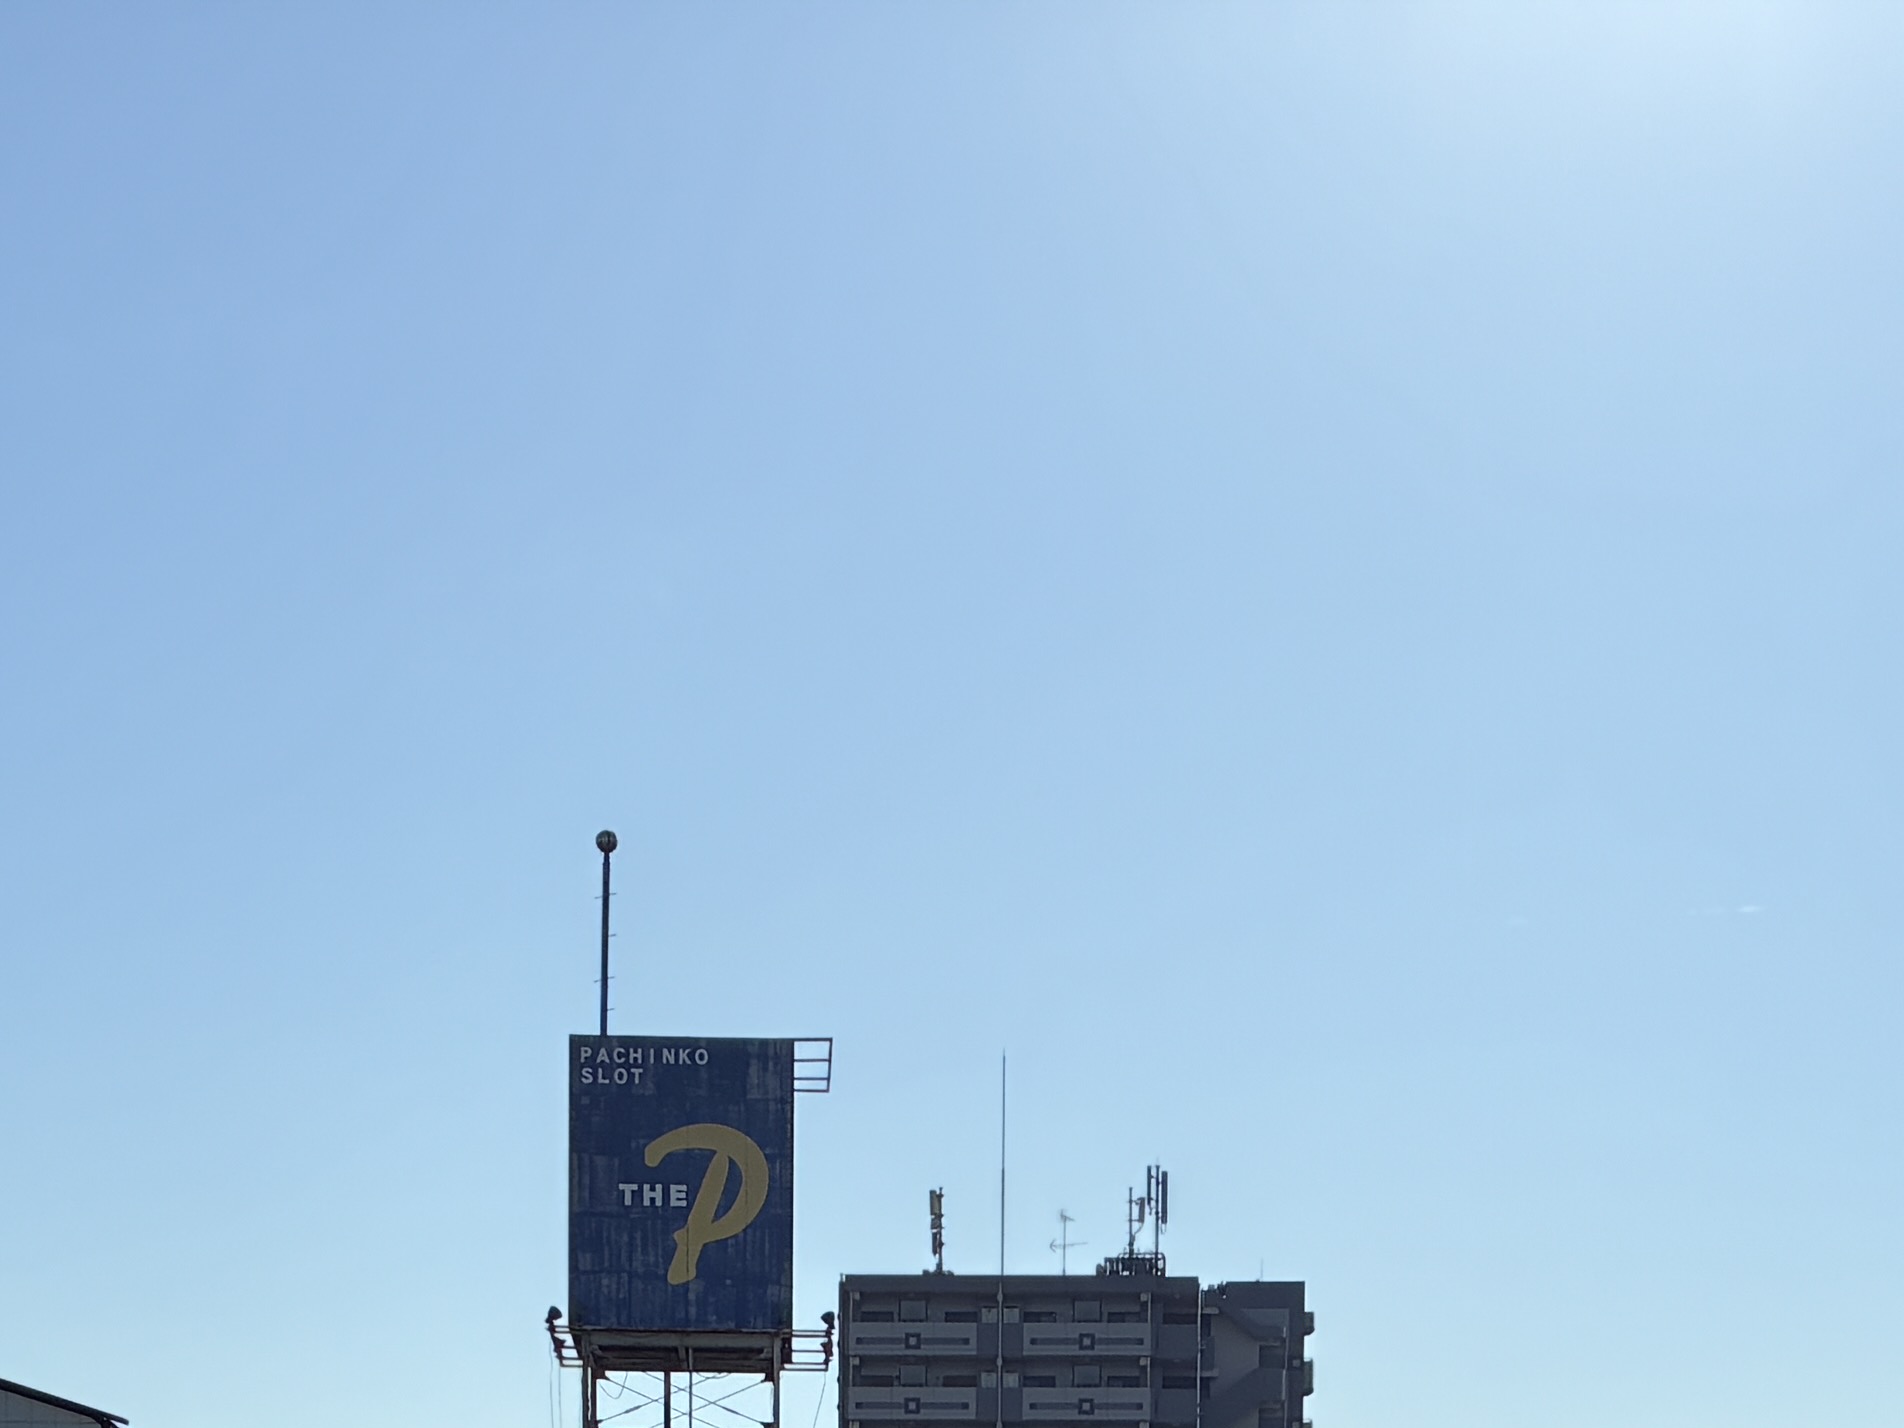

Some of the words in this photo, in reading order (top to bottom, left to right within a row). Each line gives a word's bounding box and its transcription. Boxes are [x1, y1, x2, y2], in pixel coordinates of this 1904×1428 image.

[580, 1046, 709, 1065] PACHINKO
[580, 1068, 644, 1085] SLOT
[618, 1183, 688, 1207] THE
[644, 1123, 769, 1285] P
